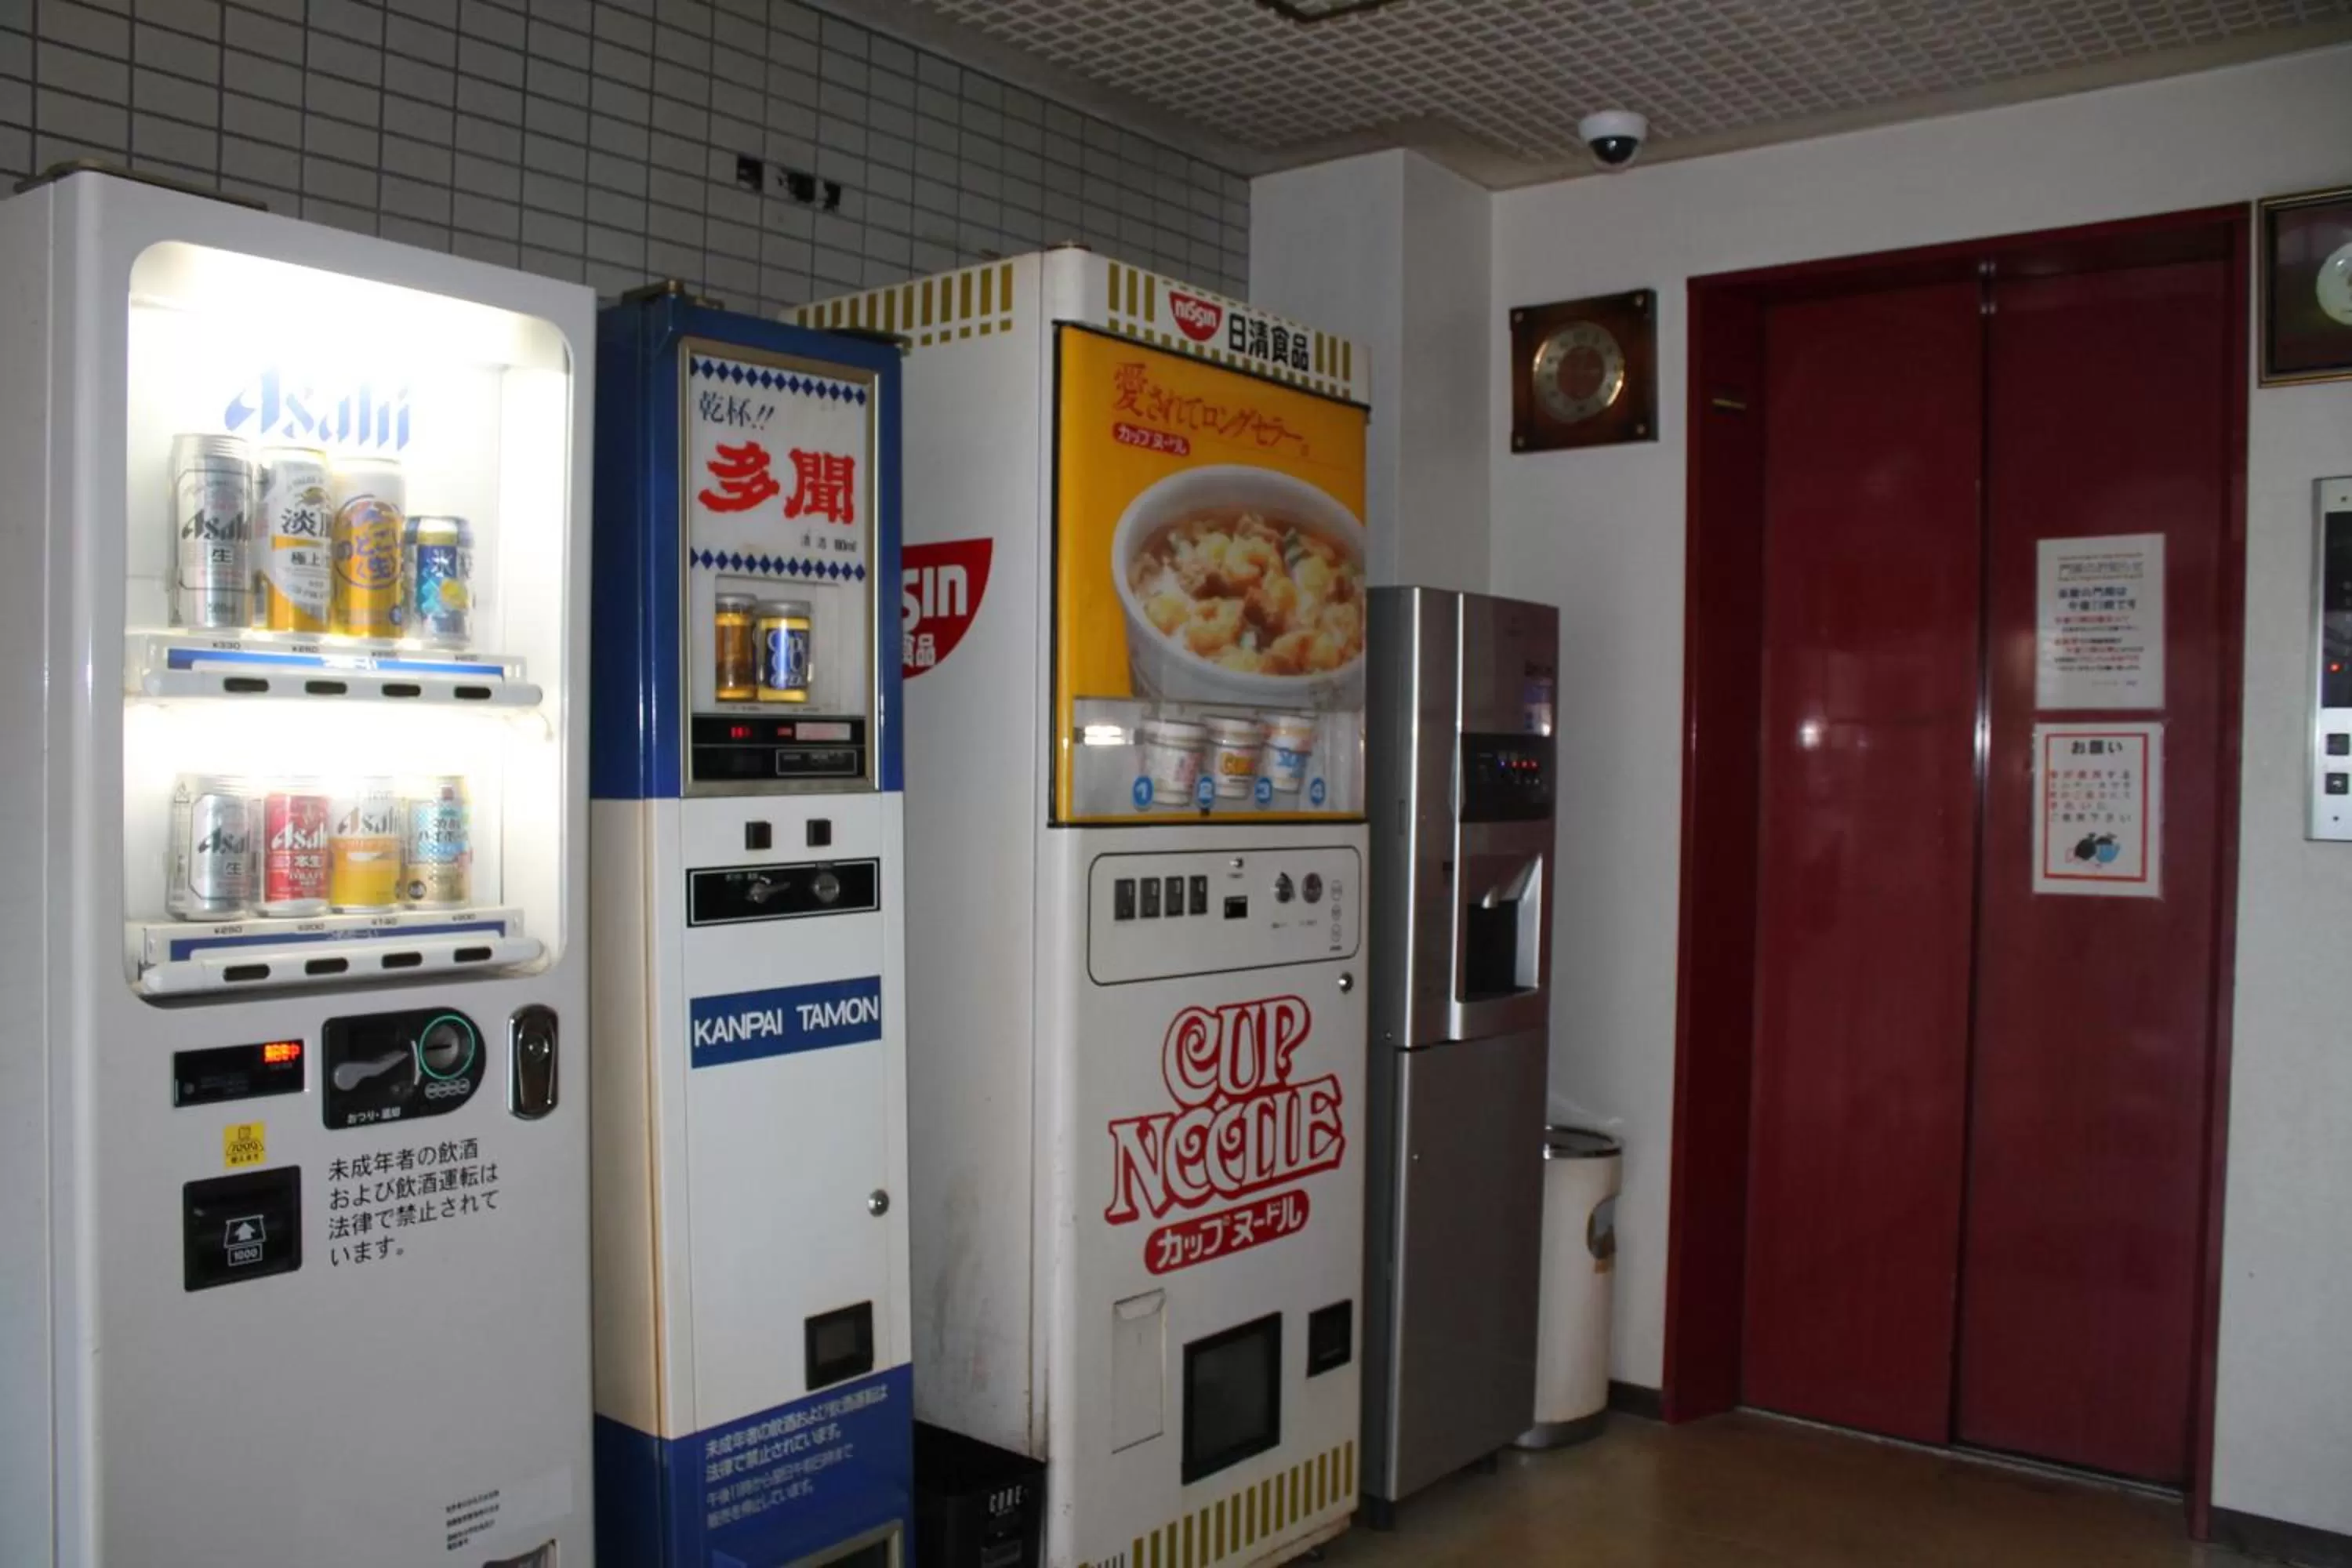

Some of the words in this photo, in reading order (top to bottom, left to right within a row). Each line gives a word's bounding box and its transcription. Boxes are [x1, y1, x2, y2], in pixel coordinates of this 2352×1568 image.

[1229, 313, 1309, 372] 日清食品
[223, 366, 411, 451] Asahi
[698, 441, 856, 525] 多聞
[1135, 782, 1148, 799] 1
[1200, 782, 1212, 798] 2
[1256, 782, 1269, 799] 3
[1312, 784, 1323, 800] 4
[694, 1008, 783, 1048] KANPAI
[796, 994, 880, 1033] TAMON
[1162, 994, 1311, 1110] CUP
[327, 1138, 480, 1181] 未成年者の飲酒
[1104, 1073, 1346, 1225] NOODLE
[328, 1163, 499, 1210] および飲酒運転は
[327, 1189, 500, 1240] 法律で禁止されて
[1156, 1195, 1302, 1269] カップヌードル
[329, 1236, 404, 1267] います。
